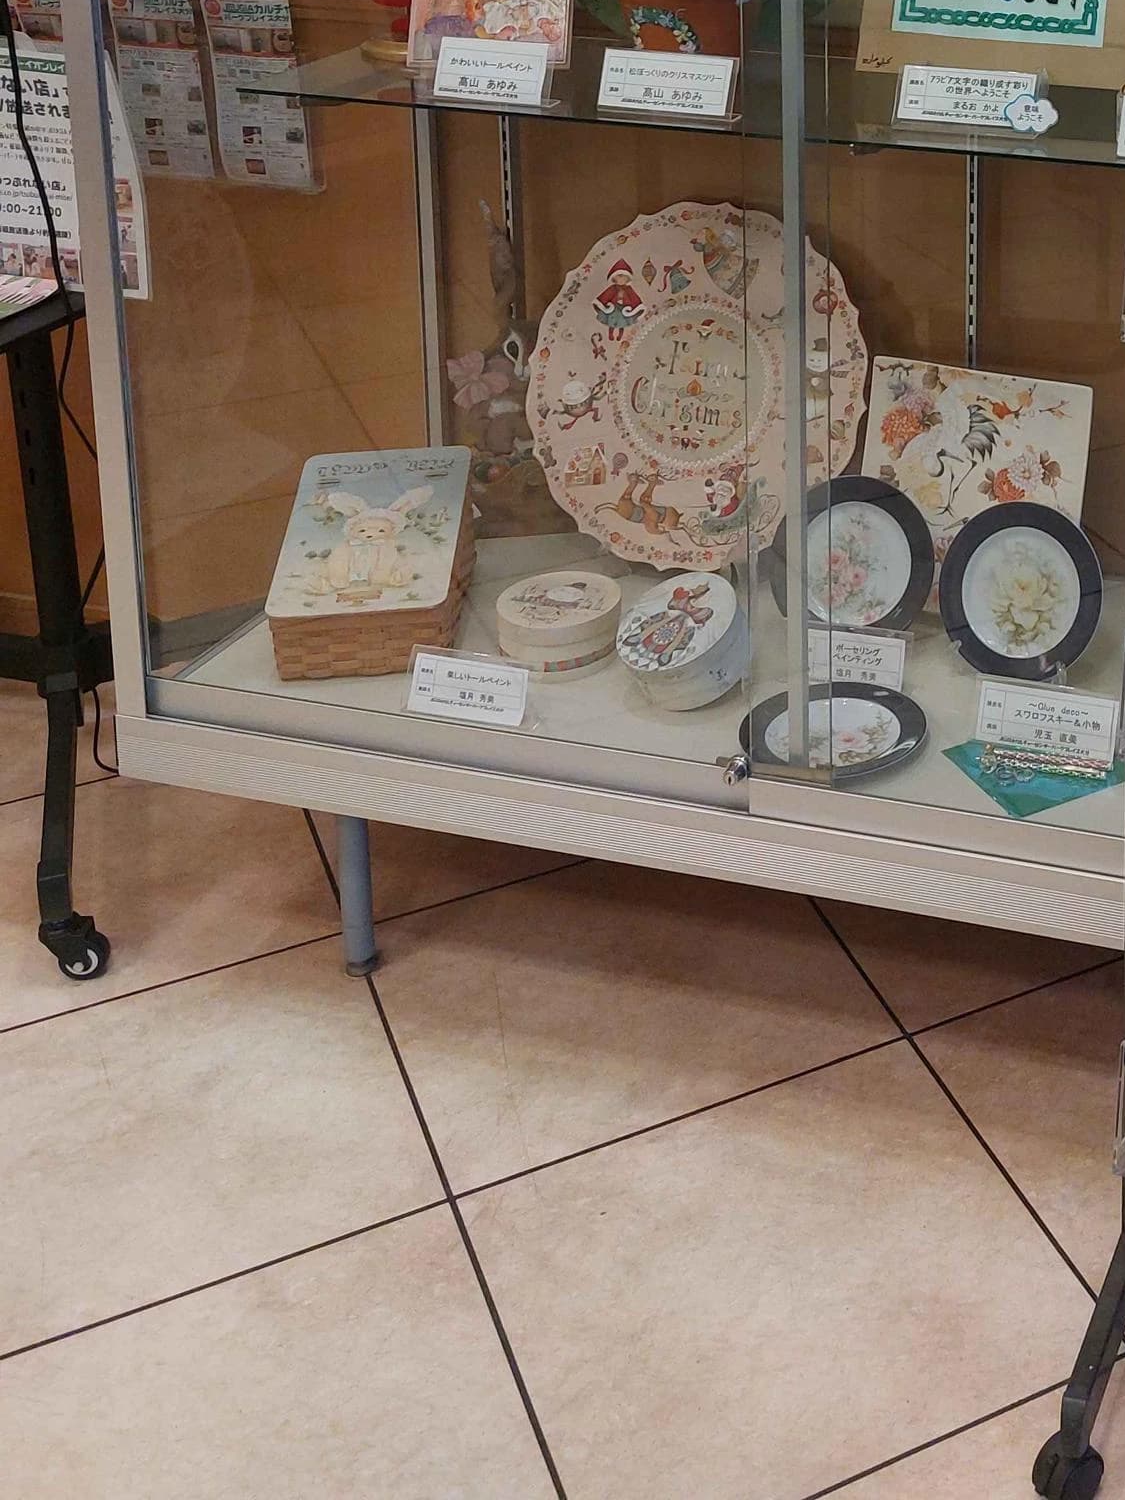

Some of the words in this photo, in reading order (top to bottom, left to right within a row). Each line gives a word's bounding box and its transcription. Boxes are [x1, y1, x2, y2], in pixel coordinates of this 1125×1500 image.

[945, 86, 1011, 99] の世界へようこそ
